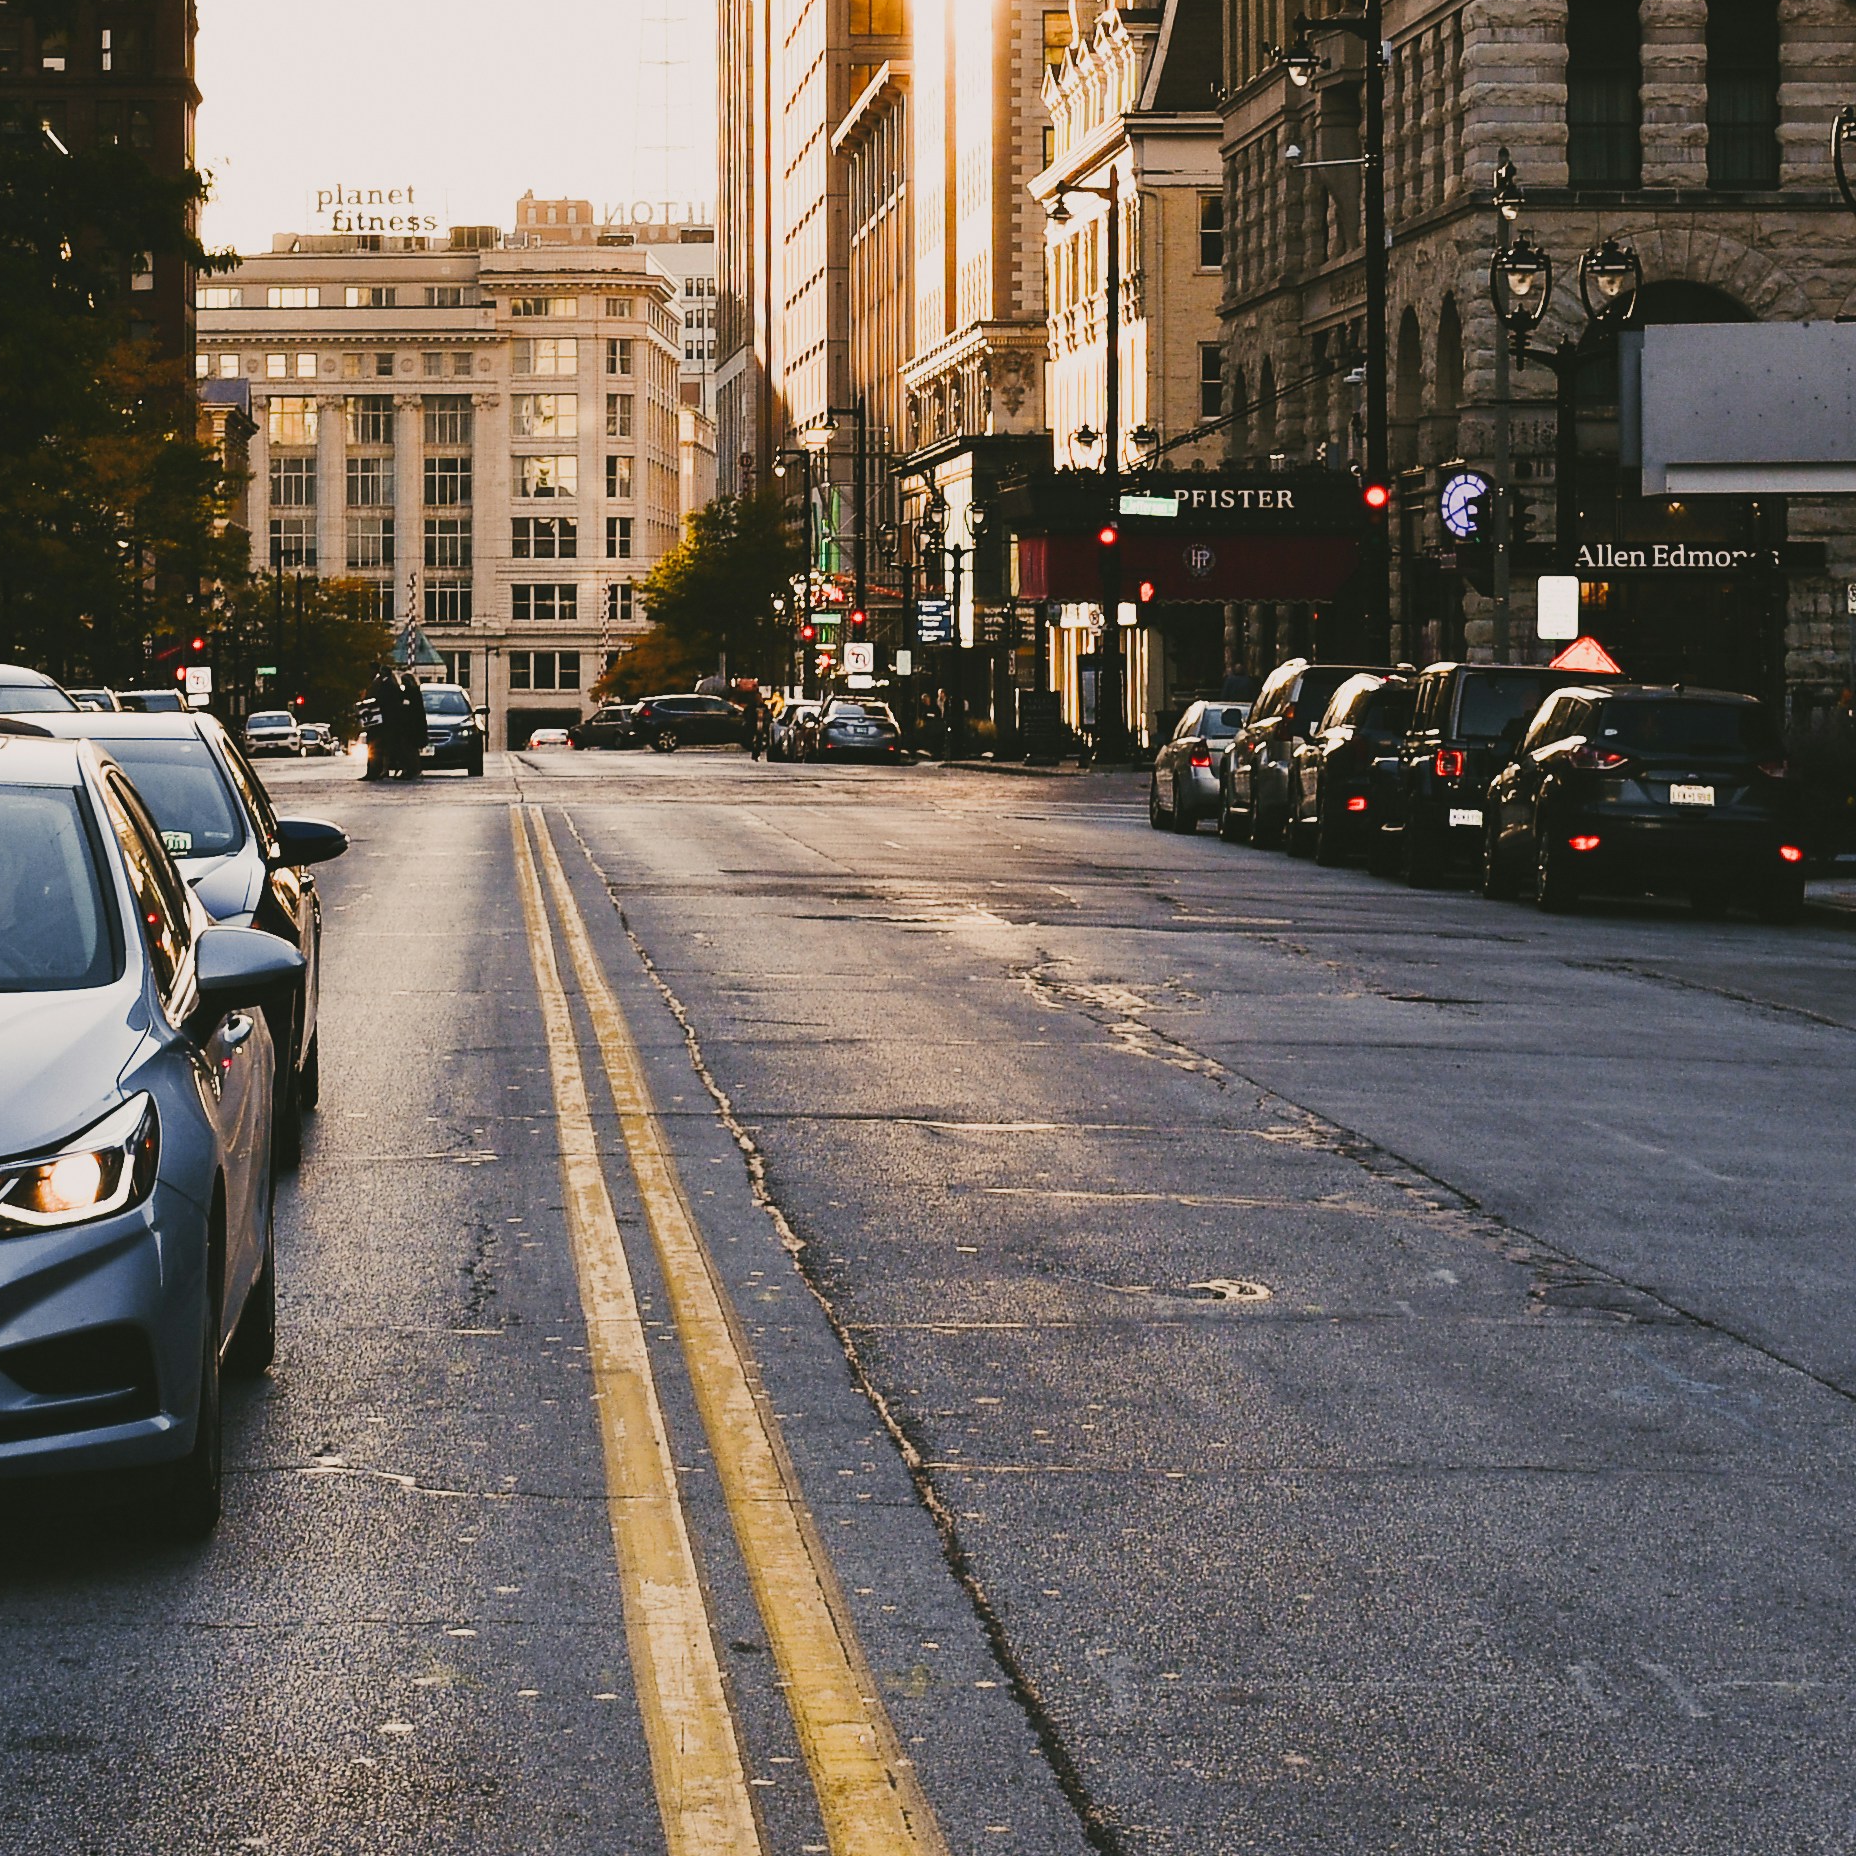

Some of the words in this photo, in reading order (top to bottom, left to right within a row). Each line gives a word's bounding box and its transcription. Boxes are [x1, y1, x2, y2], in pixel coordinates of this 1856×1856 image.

[316, 183, 415, 213] planet
[332, 210, 438, 232] fitness
[1174, 489, 1295, 509] PFISTER
[1575, 544, 1647, 567] Allen
